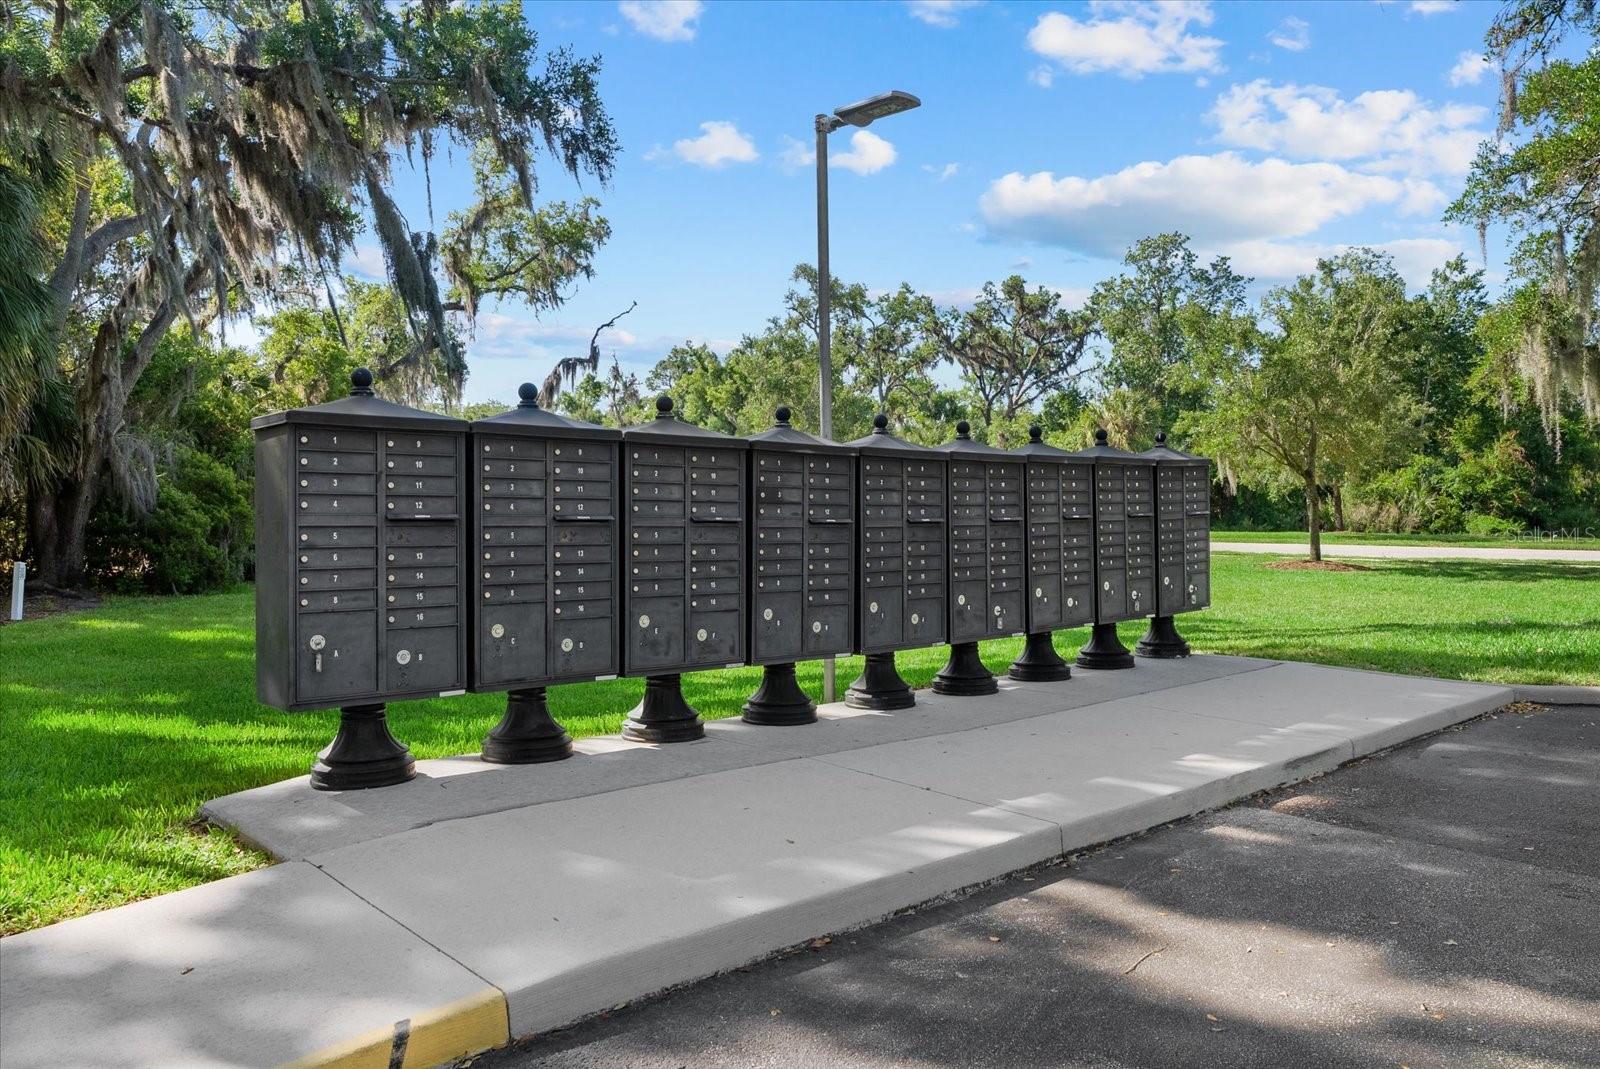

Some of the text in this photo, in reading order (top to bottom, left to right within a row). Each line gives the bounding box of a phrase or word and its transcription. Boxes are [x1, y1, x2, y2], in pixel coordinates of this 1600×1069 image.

[332, 436, 337, 445] 1
[332, 457, 338, 466] 2
[415, 460, 423, 469] 10
[332, 478, 338, 487] 3
[332, 531, 338, 540] 5
[333, 553, 338, 562] 6
[416, 552, 424, 561] 13
[333, 574, 338, 583] 7
[333, 596, 339, 605] 8
[415, 592, 424, 601] 15
[416, 612, 425, 621] 16
[333, 649, 339, 658] A
